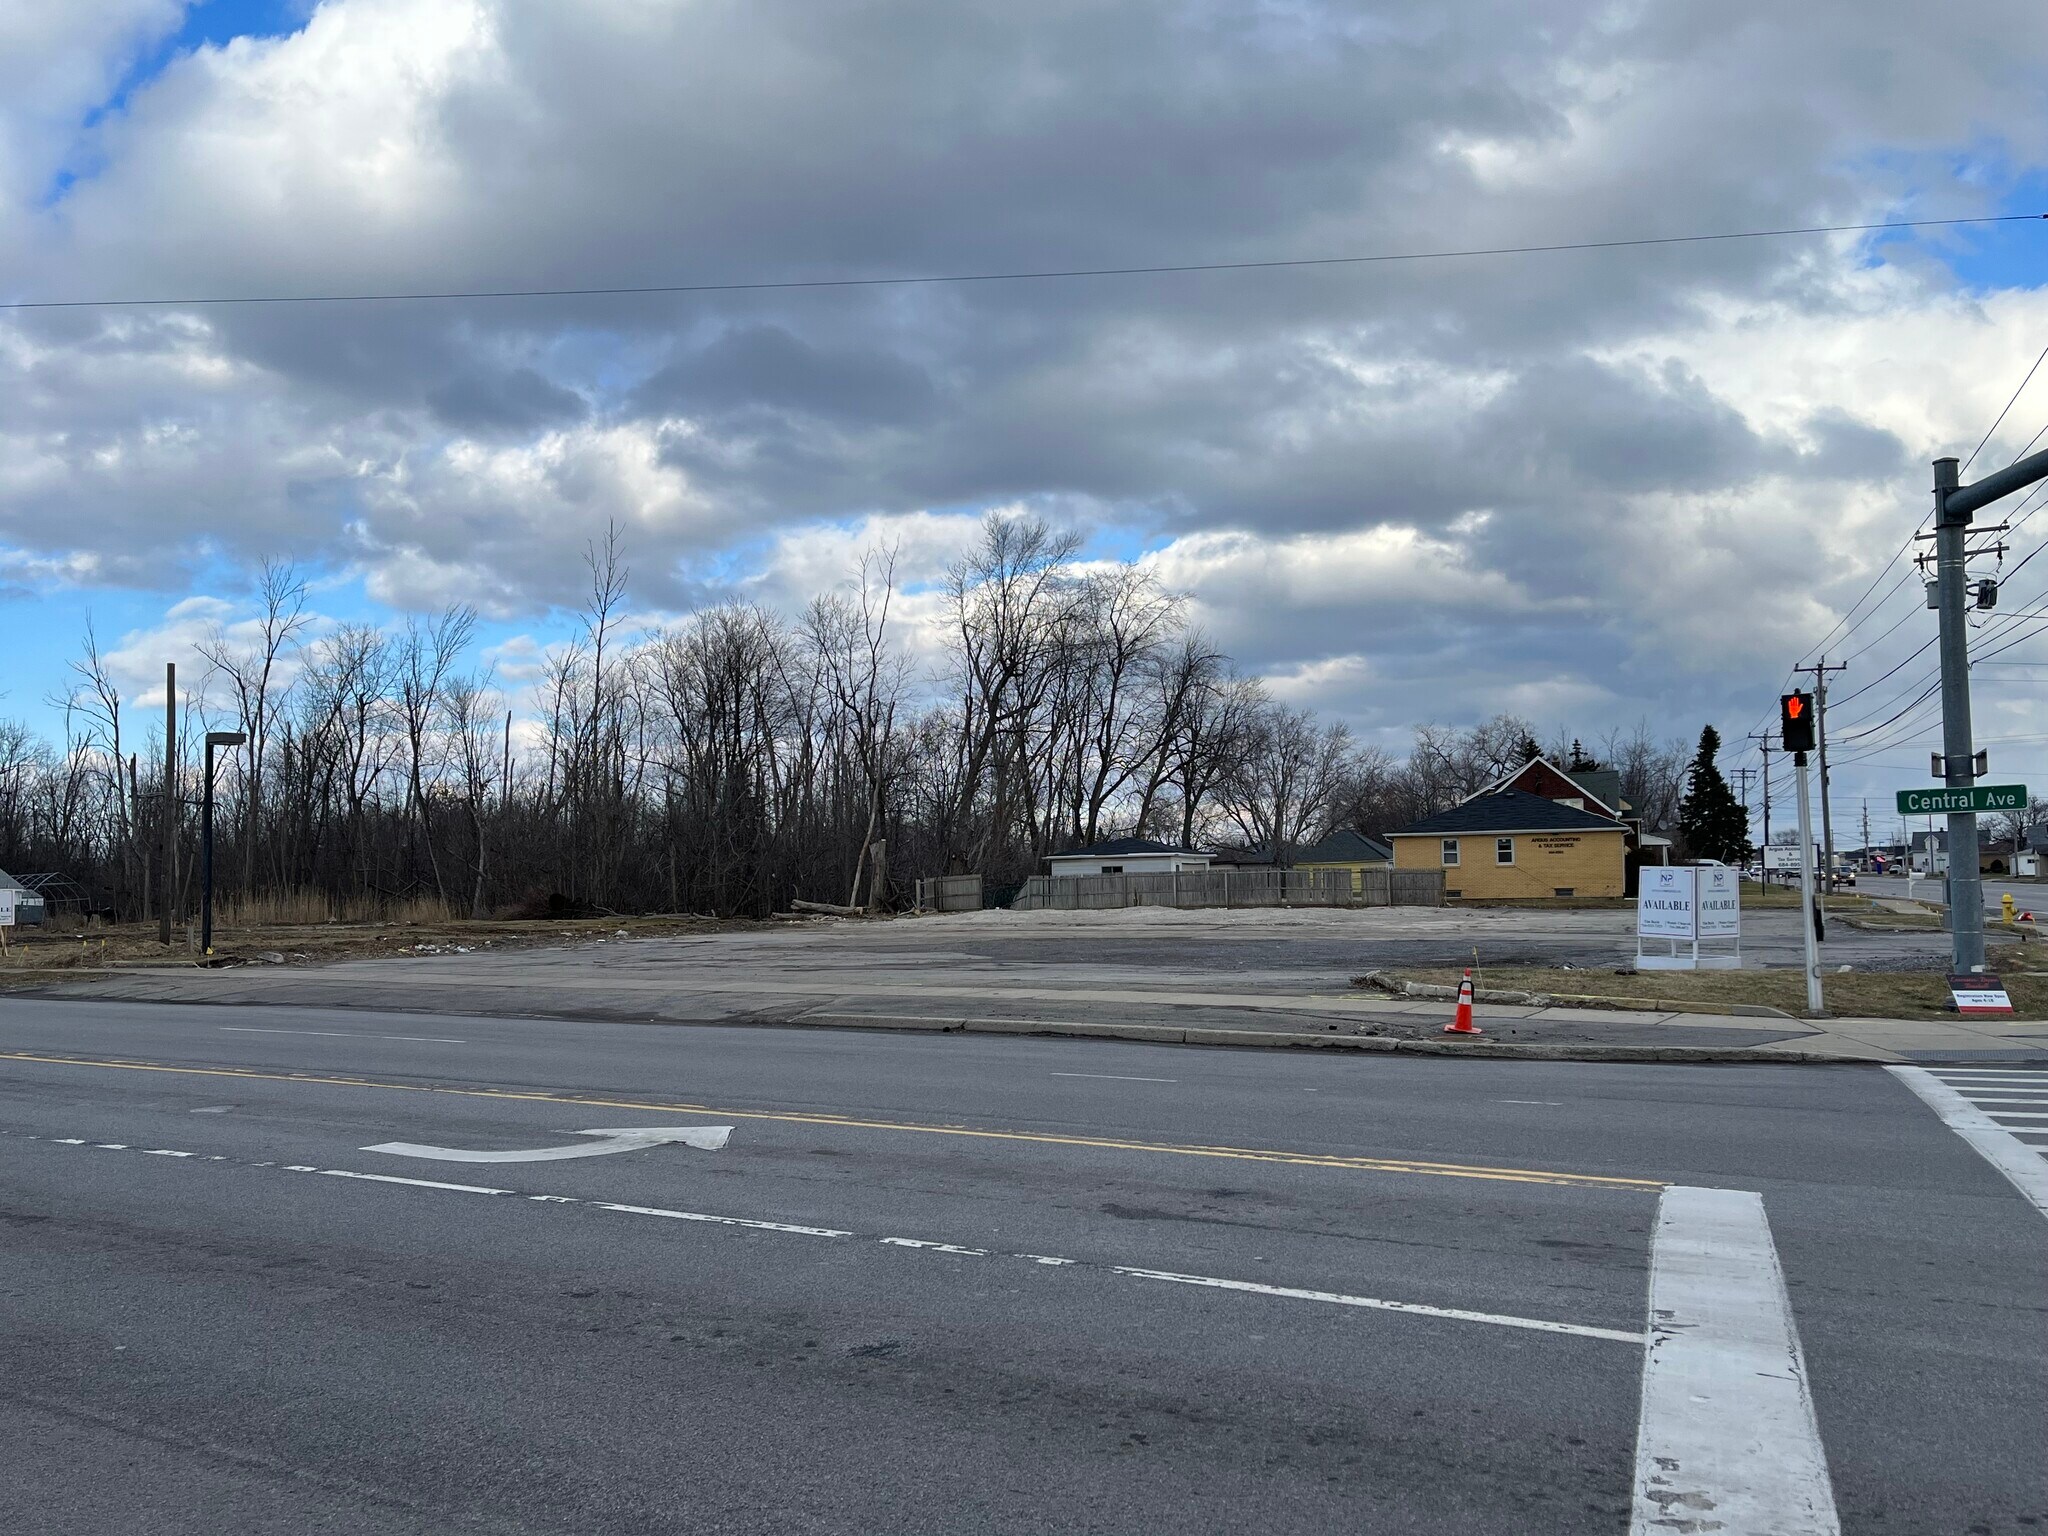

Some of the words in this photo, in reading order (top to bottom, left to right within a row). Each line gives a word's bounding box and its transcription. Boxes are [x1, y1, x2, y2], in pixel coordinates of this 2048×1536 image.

[1908, 792, 1975, 810] Central
[1986, 792, 2016, 807] Ave
[1643, 900, 1690, 911] AVAILABLE
[1702, 899, 1736, 911] AVAILABLE
